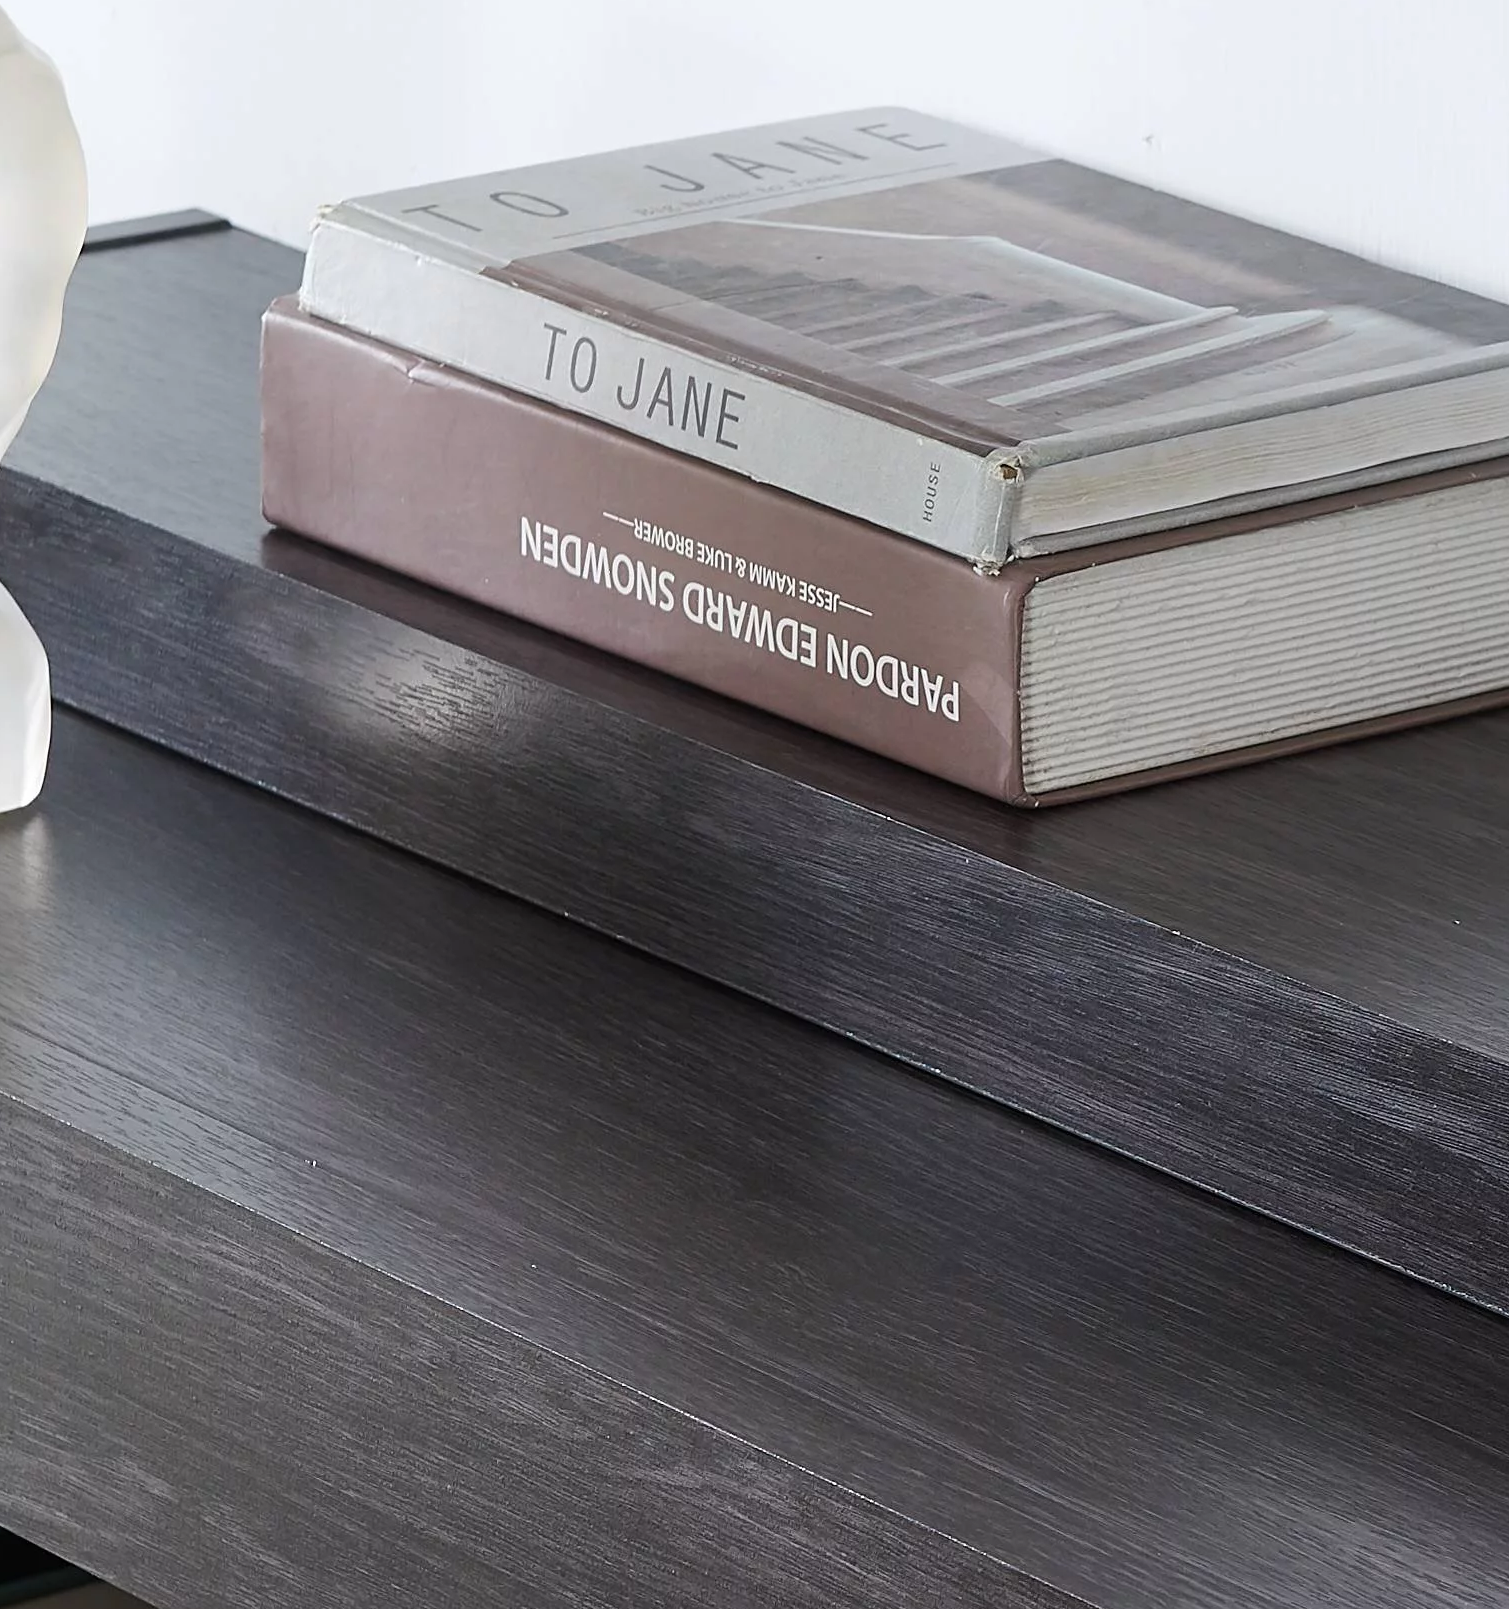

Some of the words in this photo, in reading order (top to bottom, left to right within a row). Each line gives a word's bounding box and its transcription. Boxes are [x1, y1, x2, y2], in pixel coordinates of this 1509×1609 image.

[402, 191, 570, 232] TO
[644, 123, 946, 193] JANE
[544, 322, 597, 393] TO
[617, 358, 745, 450] JANE
[923, 461, 941, 522] HOUSE
[521, 516, 675, 612] SNOWDEN
[633, 517, 694, 560] BROWER
[697, 542, 733, 572] LUKE
[735, 560, 747, 578] &
[750, 563, 796, 597] KAMM
[799, 580, 839, 613] JESSE
[683, 582, 816, 667] EDWARD
[827, 634, 960, 722] PARDON
